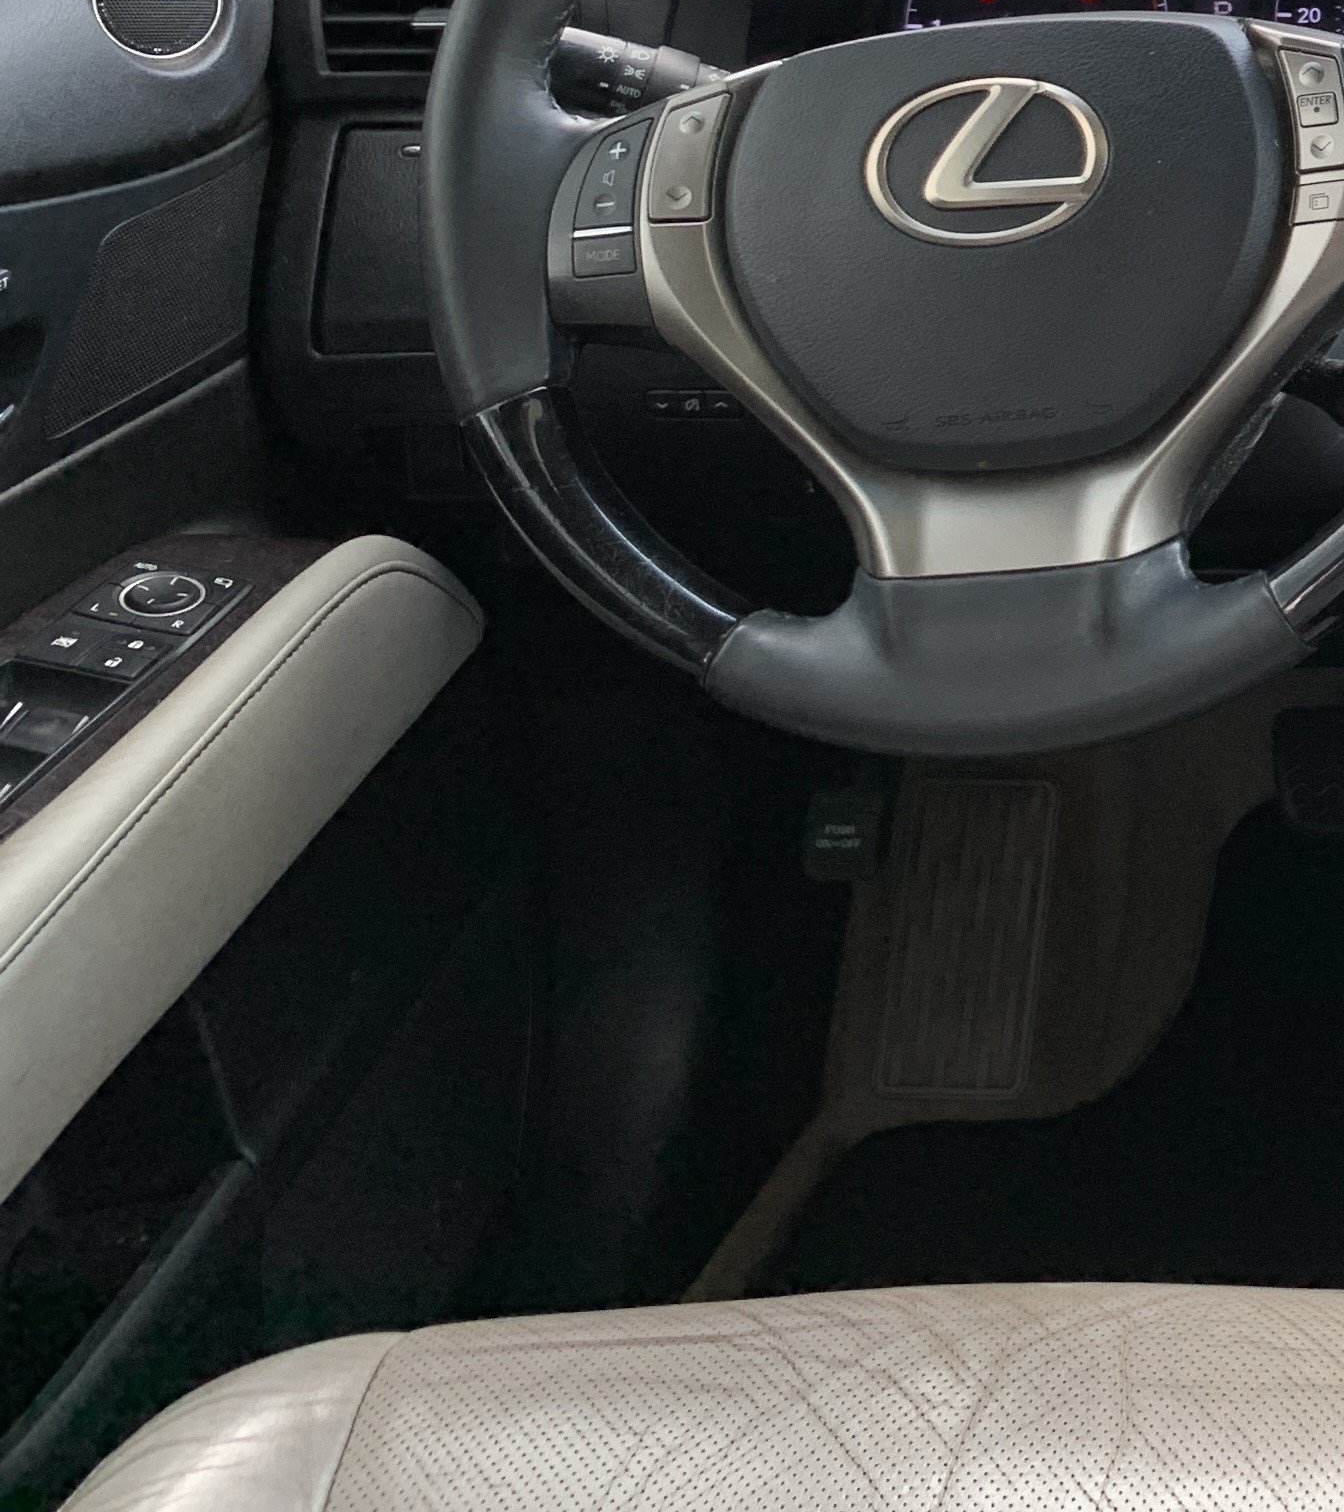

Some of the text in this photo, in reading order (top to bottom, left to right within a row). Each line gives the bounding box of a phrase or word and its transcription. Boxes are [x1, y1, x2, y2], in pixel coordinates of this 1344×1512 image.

[1297, 7, 1321, 24] 20
[616, 84, 641, 98] AUTO
[1300, 95, 1331, 107] ENTER
[587, 248, 621, 261] MODE
[90, 603, 99, 612] L
[171, 619, 184, 629] R
